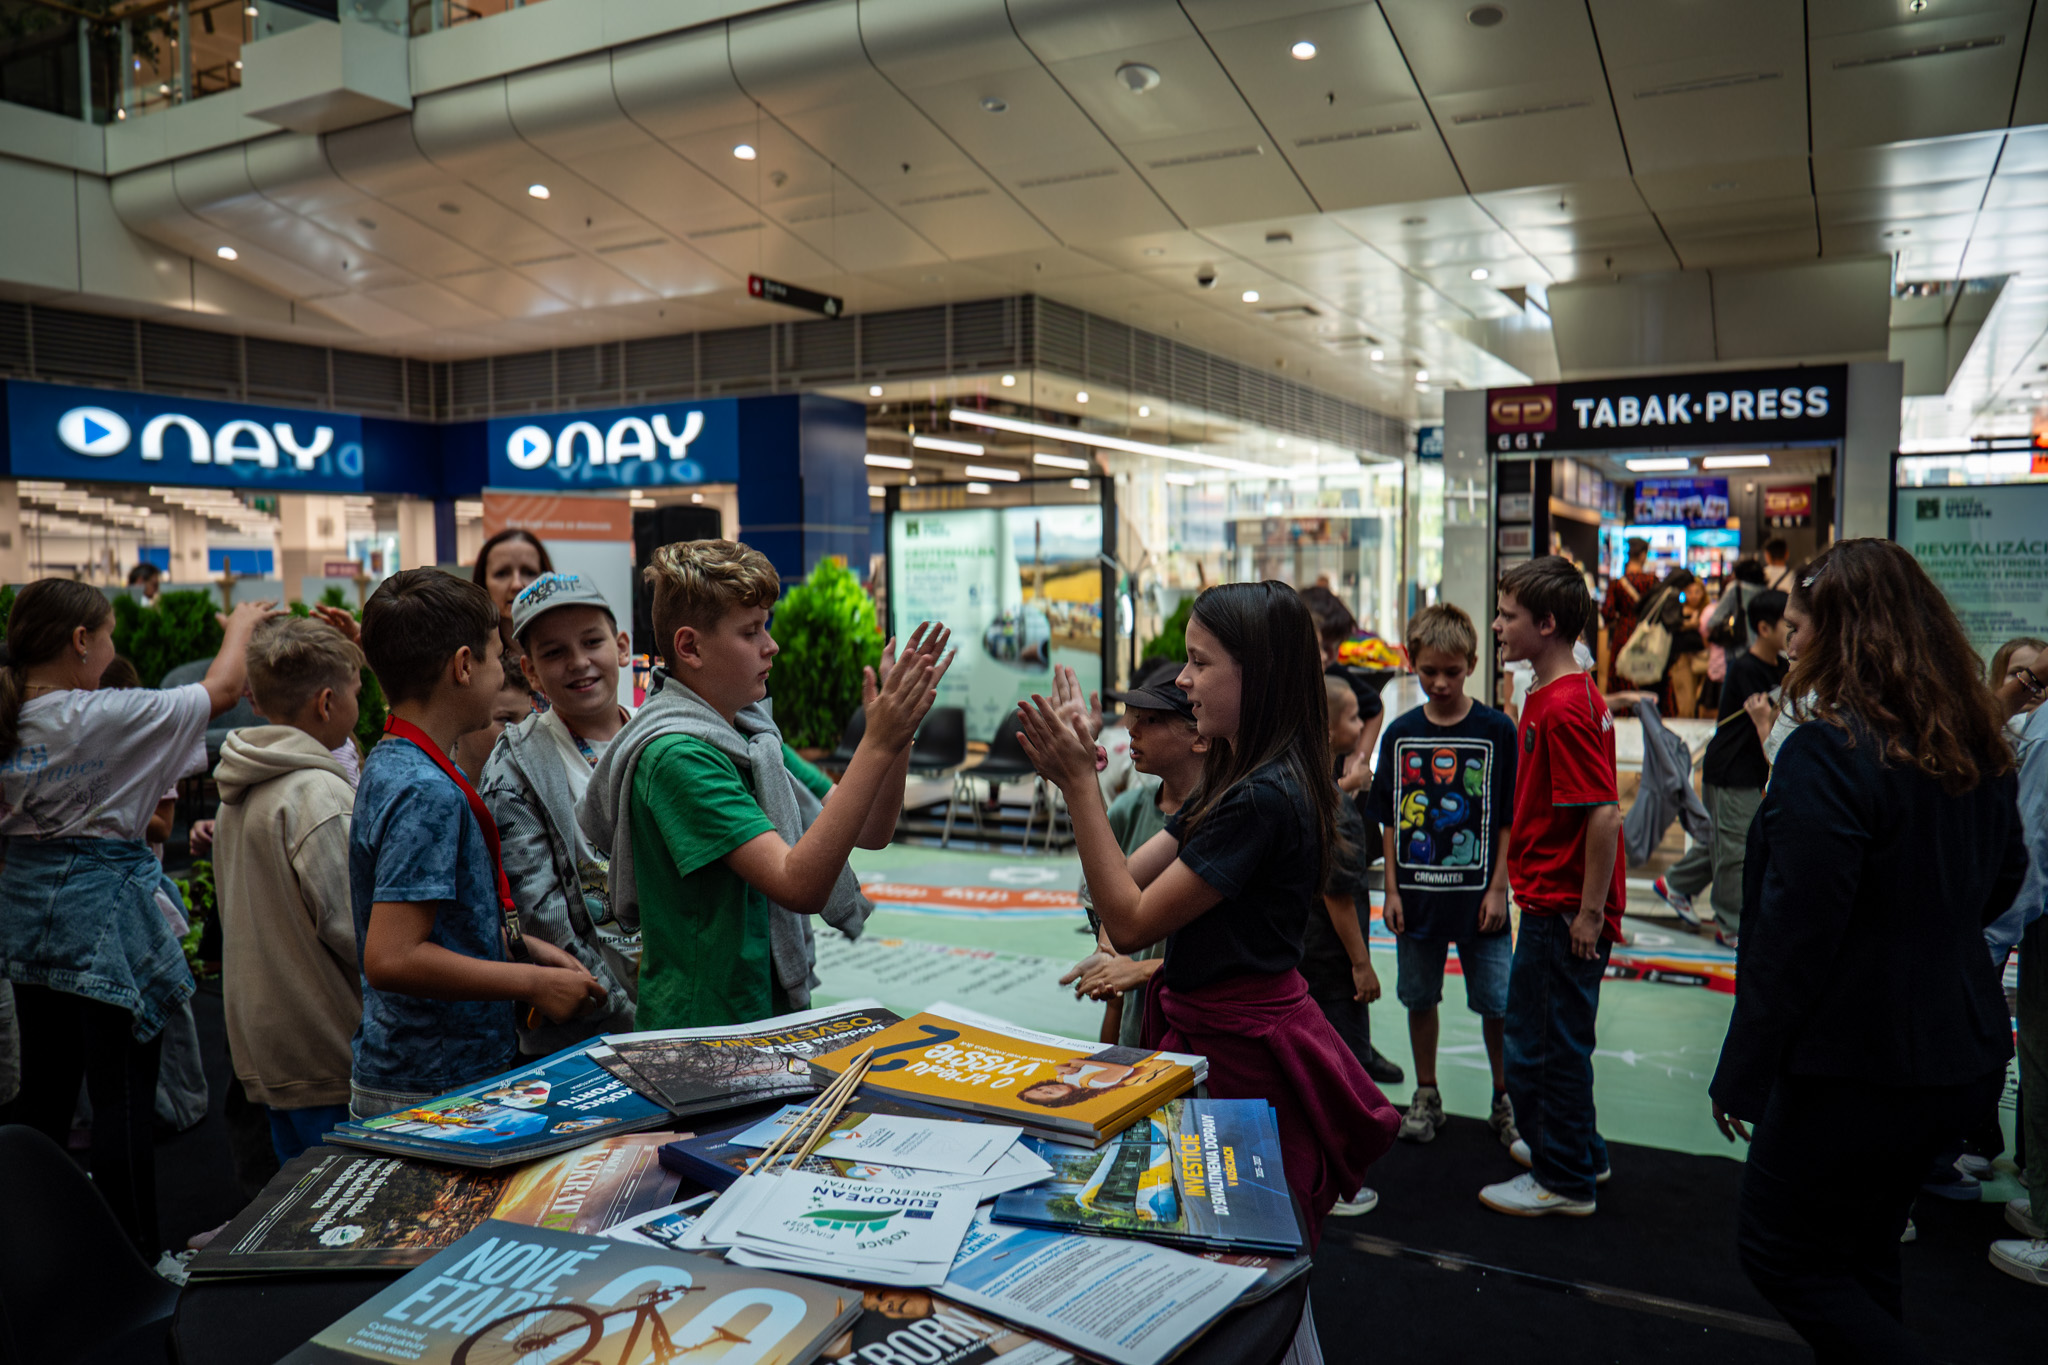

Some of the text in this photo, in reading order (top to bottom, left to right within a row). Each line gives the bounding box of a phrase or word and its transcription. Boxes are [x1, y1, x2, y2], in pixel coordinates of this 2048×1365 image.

[752, 1039, 812, 1056] ÉRA
[1176, 1134, 1206, 1196] INVESTÍCIE
[812, 1186, 940, 1209] EUROPEAN
[823, 1180, 943, 1199] GREEN CAPITAL
[857, 1229, 911, 1250] KOŠICE
[443, 1237, 612, 1293] NOVÉ
[836, 1307, 996, 1365] BORN
